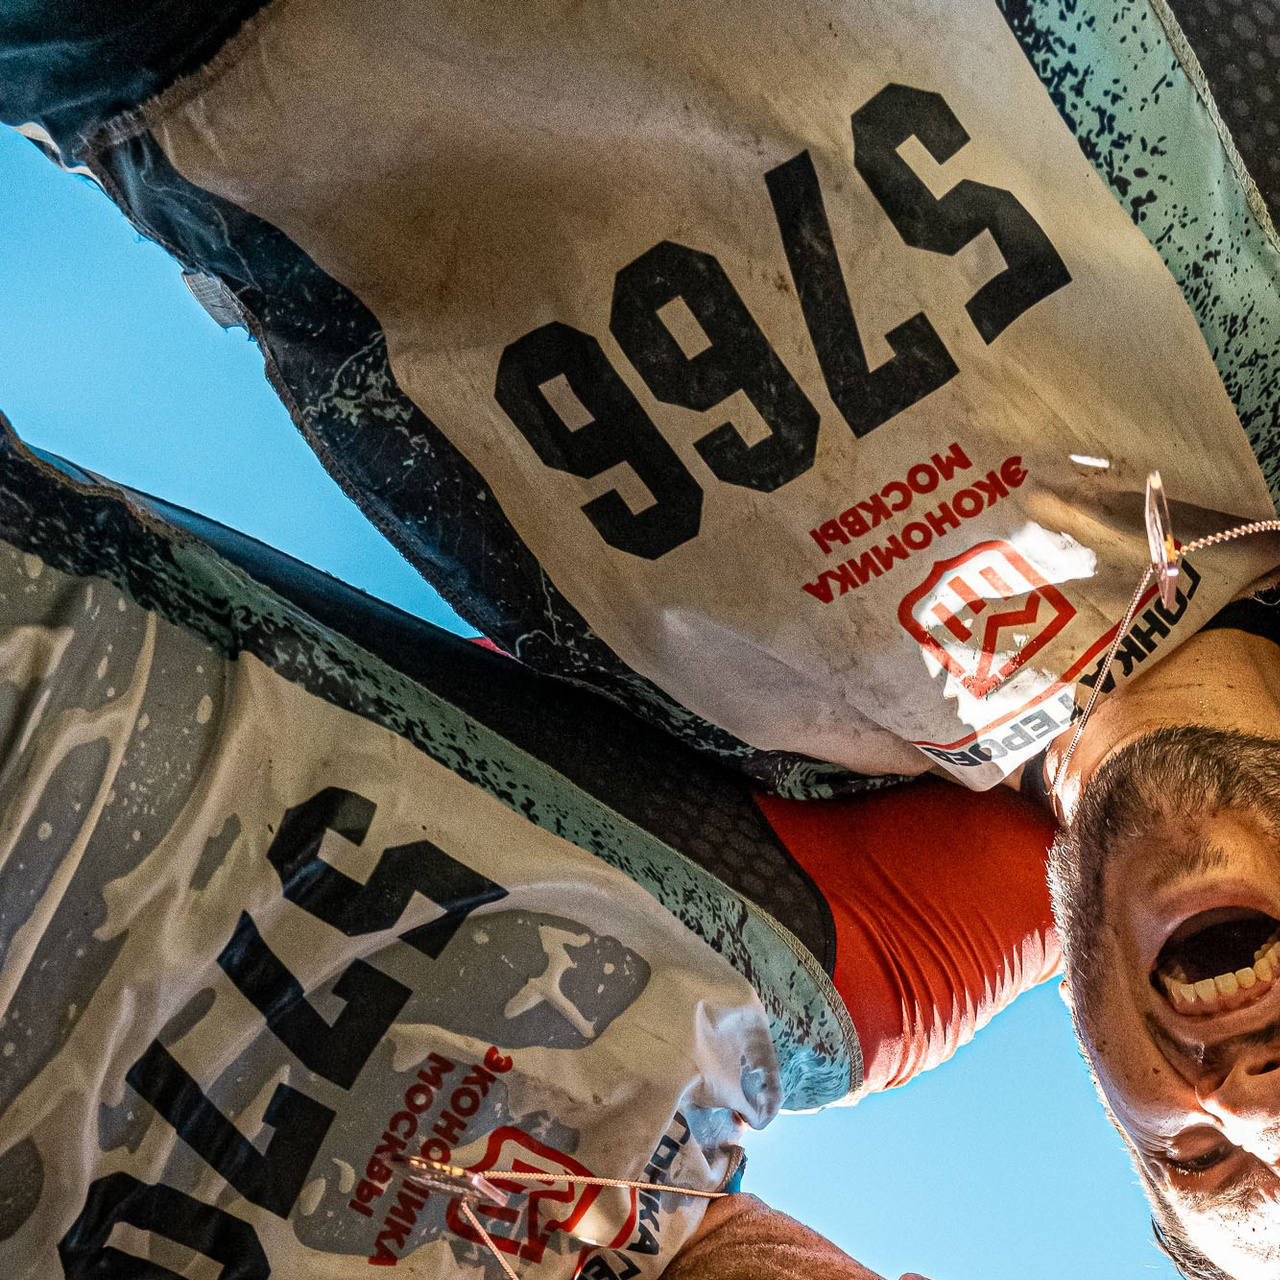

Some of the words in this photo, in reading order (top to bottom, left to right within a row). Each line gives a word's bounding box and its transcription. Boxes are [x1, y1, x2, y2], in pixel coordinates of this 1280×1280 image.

[494, 83, 1072, 559] 5766
[801, 456, 1029, 605] ЭКОНОМИКА
[810, 442, 973, 555] МОСКВЫ
[368, 1045, 514, 1267] ЭКОНОИКА
